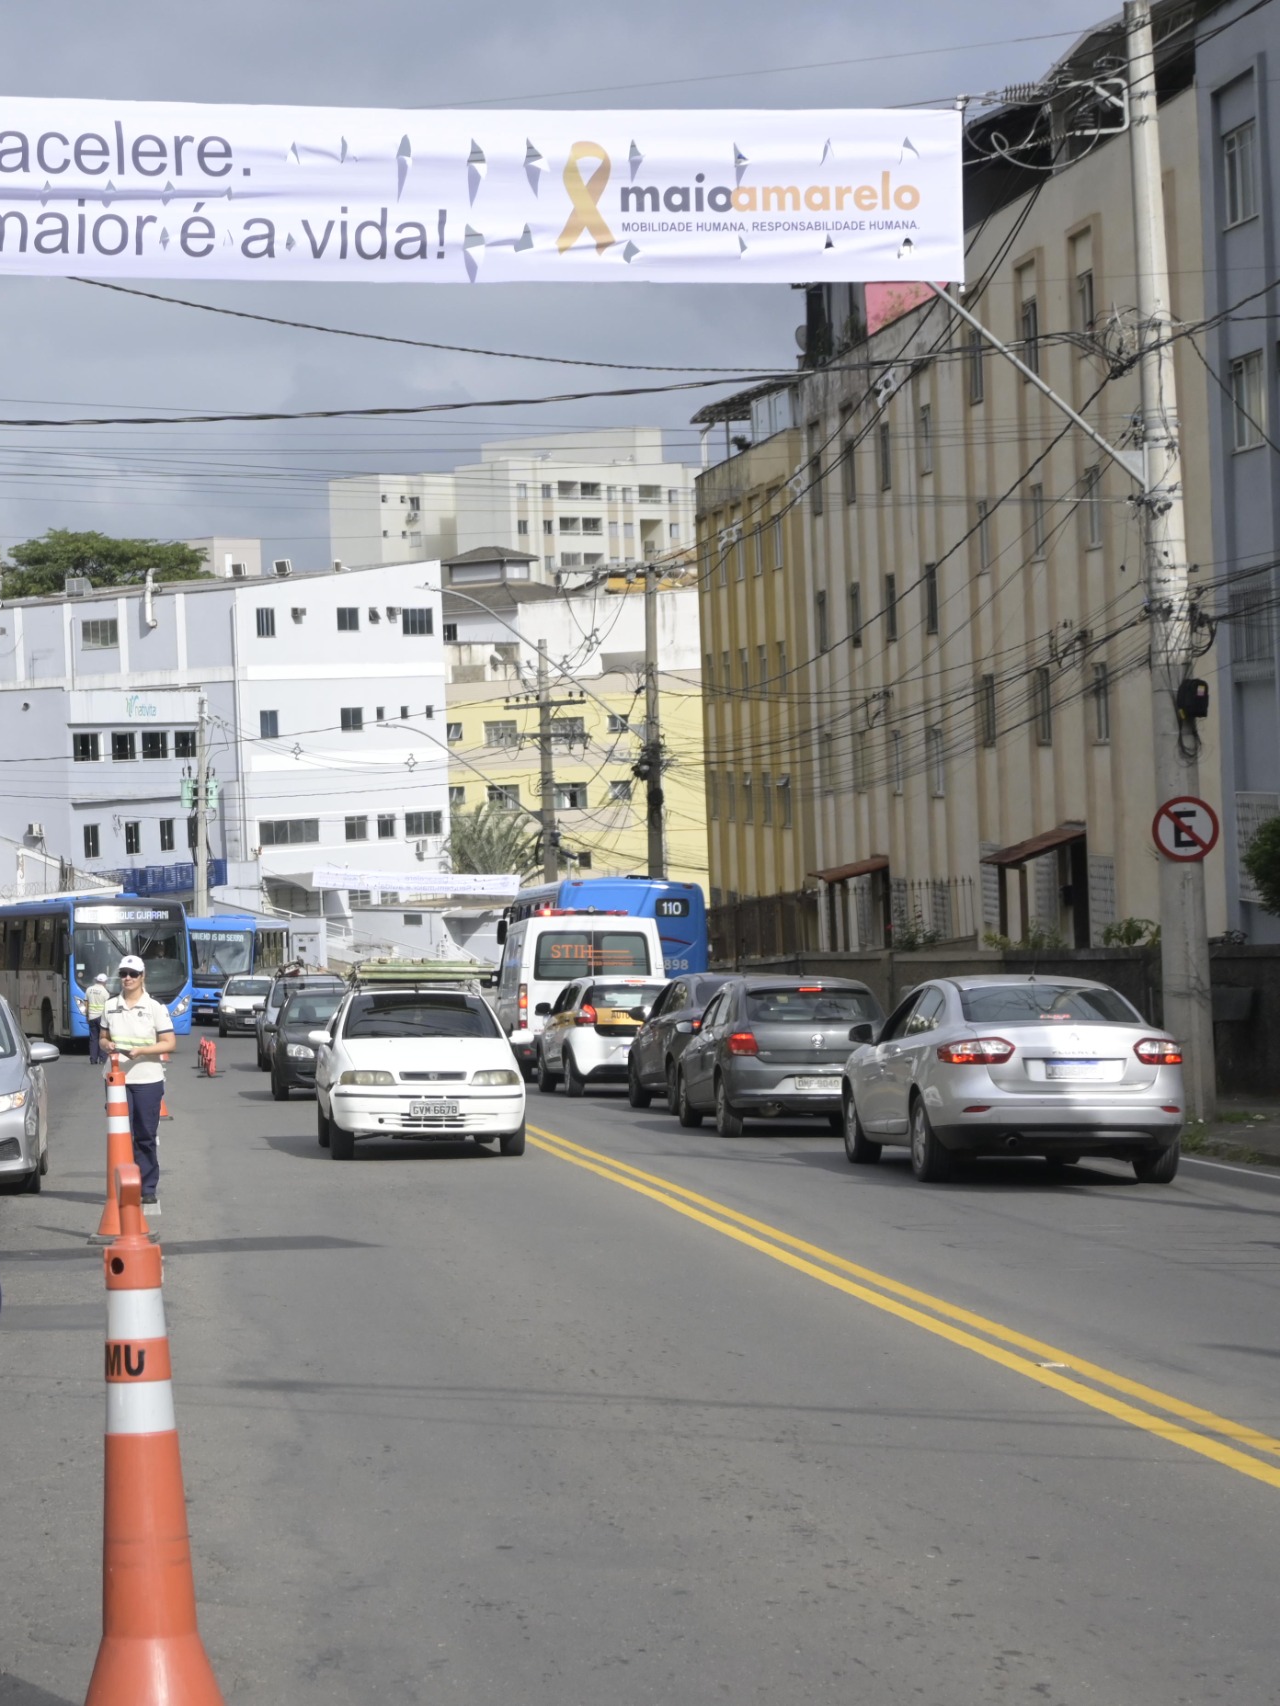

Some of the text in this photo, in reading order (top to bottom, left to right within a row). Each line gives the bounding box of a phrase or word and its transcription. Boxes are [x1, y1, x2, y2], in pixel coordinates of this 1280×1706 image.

[178, 203, 216, 258] é
[239, 215, 275, 259] a
[300, 206, 448, 260] vida!
[621, 220, 921, 233] MOBILIDADE HUMANA, RESPONSABILIDADE HUMANA.
[661, 901, 682, 915] 110
